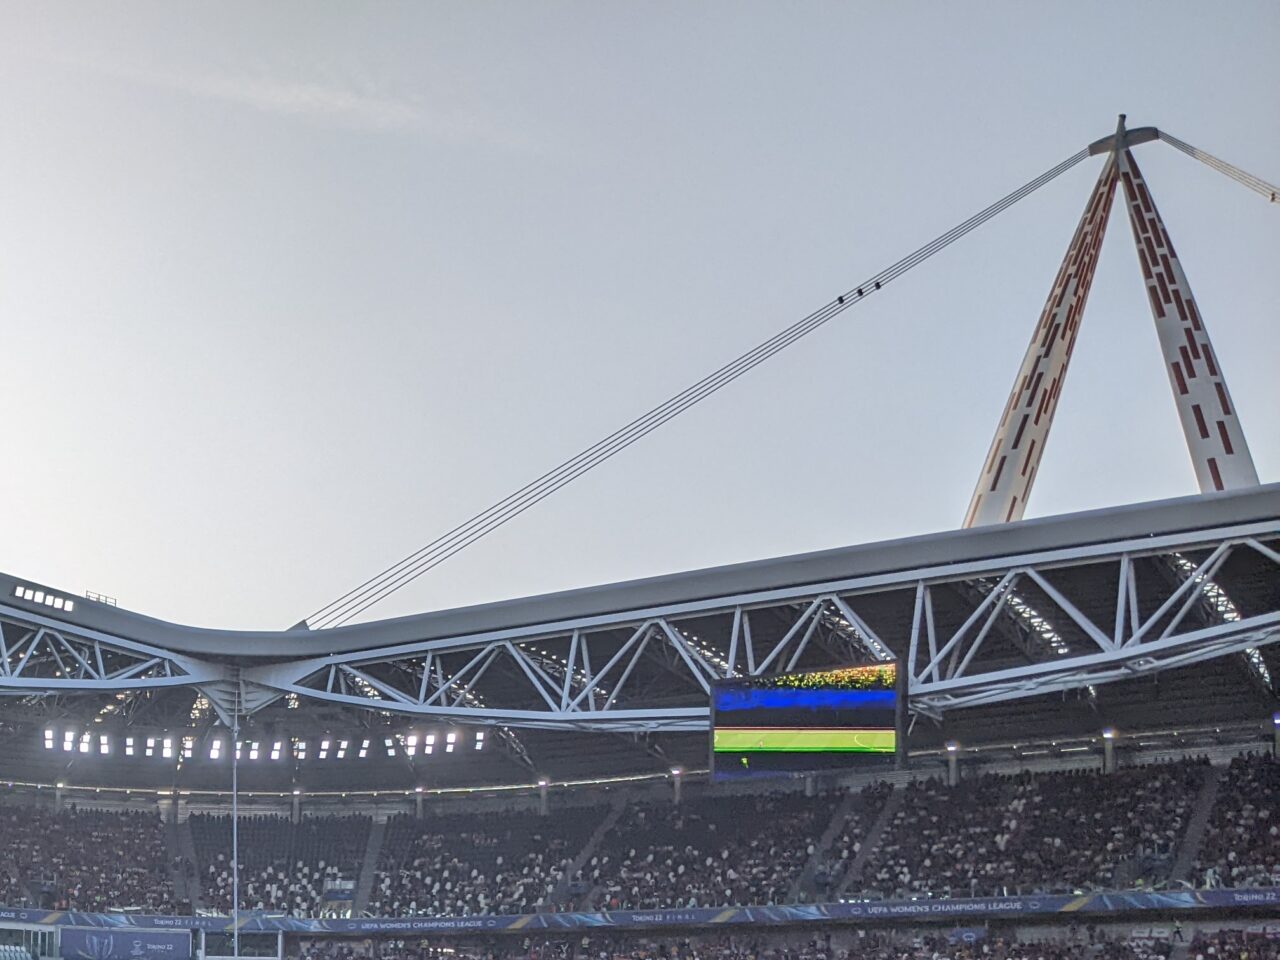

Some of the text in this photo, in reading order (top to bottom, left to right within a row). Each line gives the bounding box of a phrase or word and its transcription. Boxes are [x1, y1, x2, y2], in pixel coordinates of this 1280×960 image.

[867, 901, 1023, 914] UEFA WOMEN'S CHAMPIONS LEAGUE
[412, 921, 455, 929] CHAMPIONS
[456, 920, 482, 928] LEAGUE
